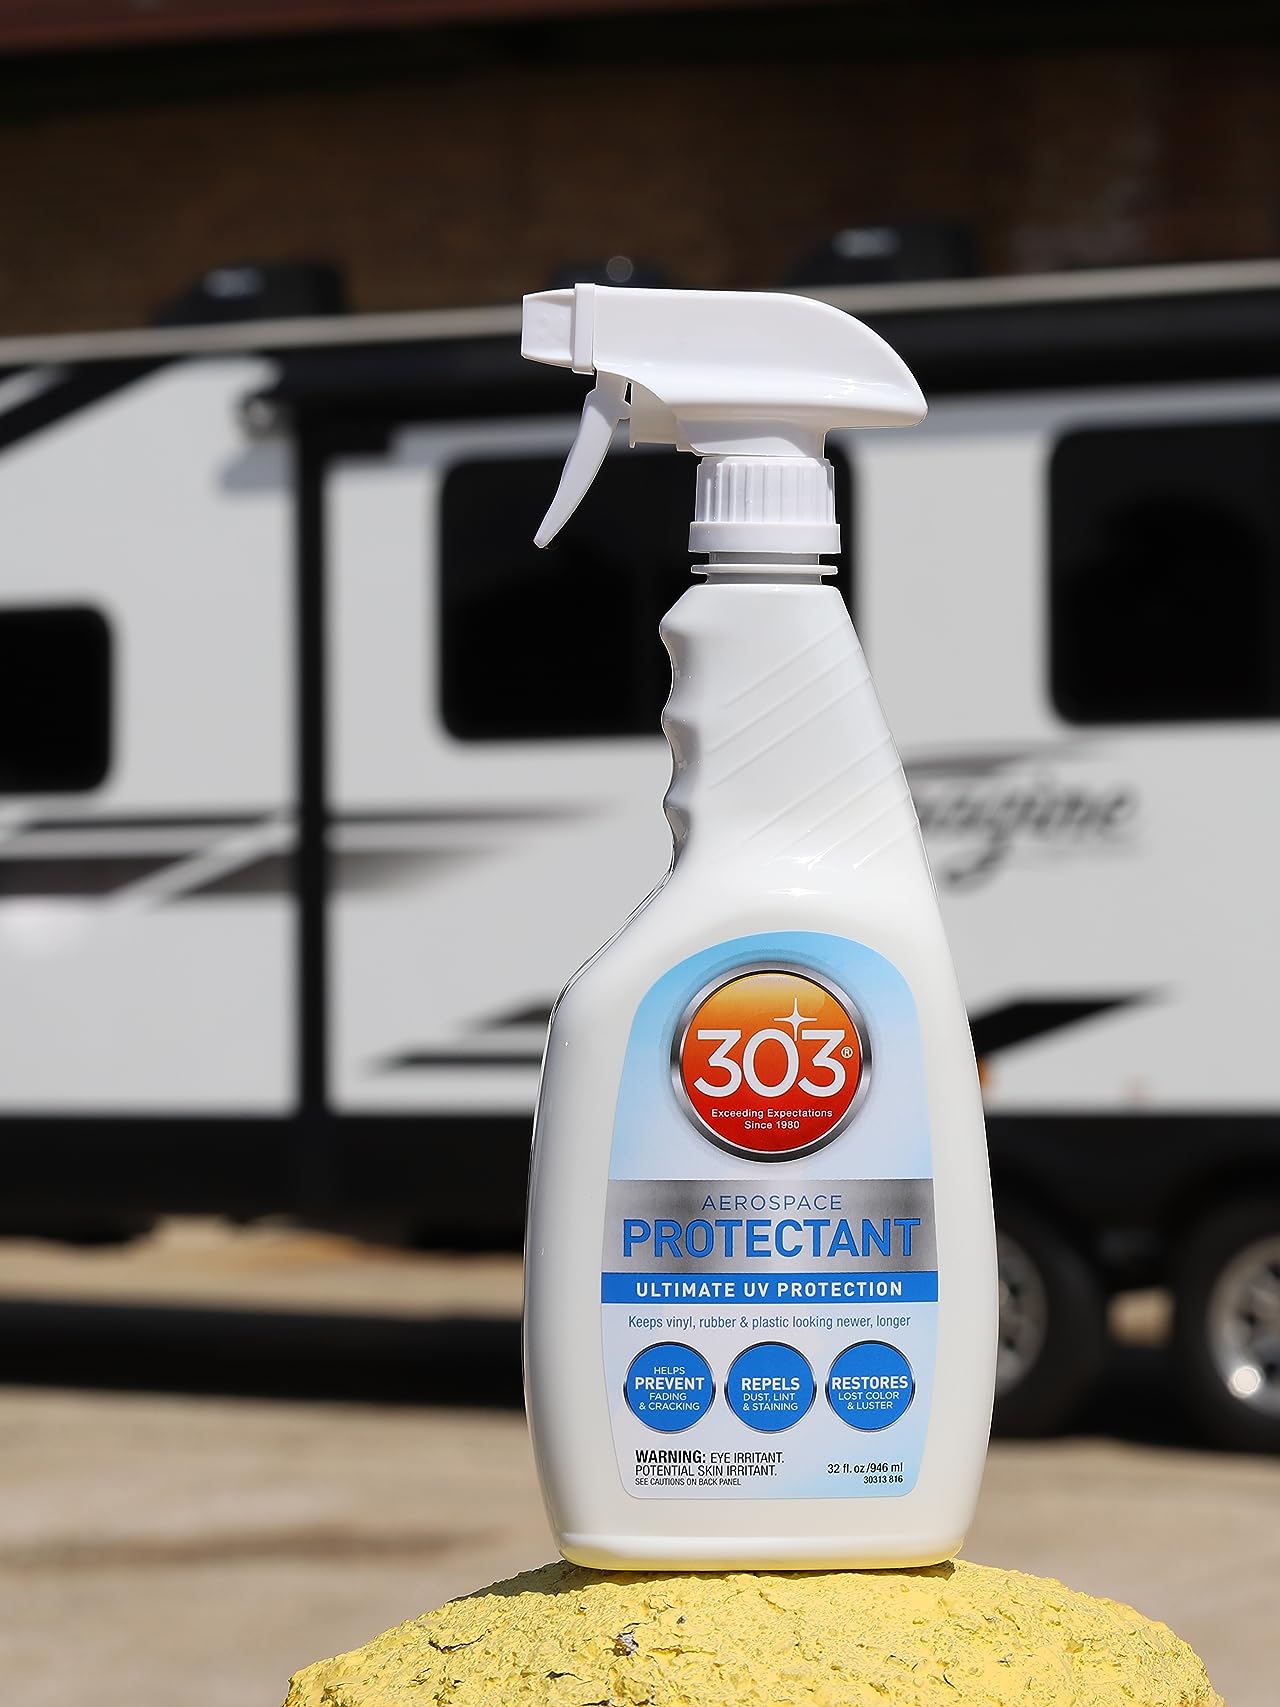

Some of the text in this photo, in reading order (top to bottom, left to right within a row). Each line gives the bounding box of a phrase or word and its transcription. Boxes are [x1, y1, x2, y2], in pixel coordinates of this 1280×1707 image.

[711, 1108, 833, 1119] Exceeding Expectations
[744, 1120, 800, 1129] Since 1980
[701, 1194, 842, 1211] AEROSPACE
[623, 1218, 921, 1257] PROTECTANT
[636, 1281, 903, 1297] ULTIMATE UV PROTECTION
[628, 1314, 911, 1330] Keeps vinyl, rubber & plastic looking newer, longer
[653, 1367, 685, 1375] HELPS
[635, 1377, 705, 1390] PREVENT
[741, 1377, 800, 1391] REPELS
[831, 1375, 908, 1390] RESTORES
[649, 1392, 687, 1401] FADING
[743, 1392, 795, 1402] DUST, LINT
[838, 1391, 899, 1400] LOST COLOR
[639, 1401, 700, 1411] & CRACKING
[742, 1401, 798, 1411] & STAINING
[847, 1400, 893, 1410] & LUSTER
[635, 1450, 784, 1463] WARNING: EYE IRRITANT.
[635, 1465, 777, 1476] POTENTIAL SKIN IRRITANT.
[827, 1463, 840, 1473] 32
[891, 1462, 903, 1472] ml
[650, 1478, 685, 1486] CAUTIONS
[863, 1475, 887, 1484] 30313
